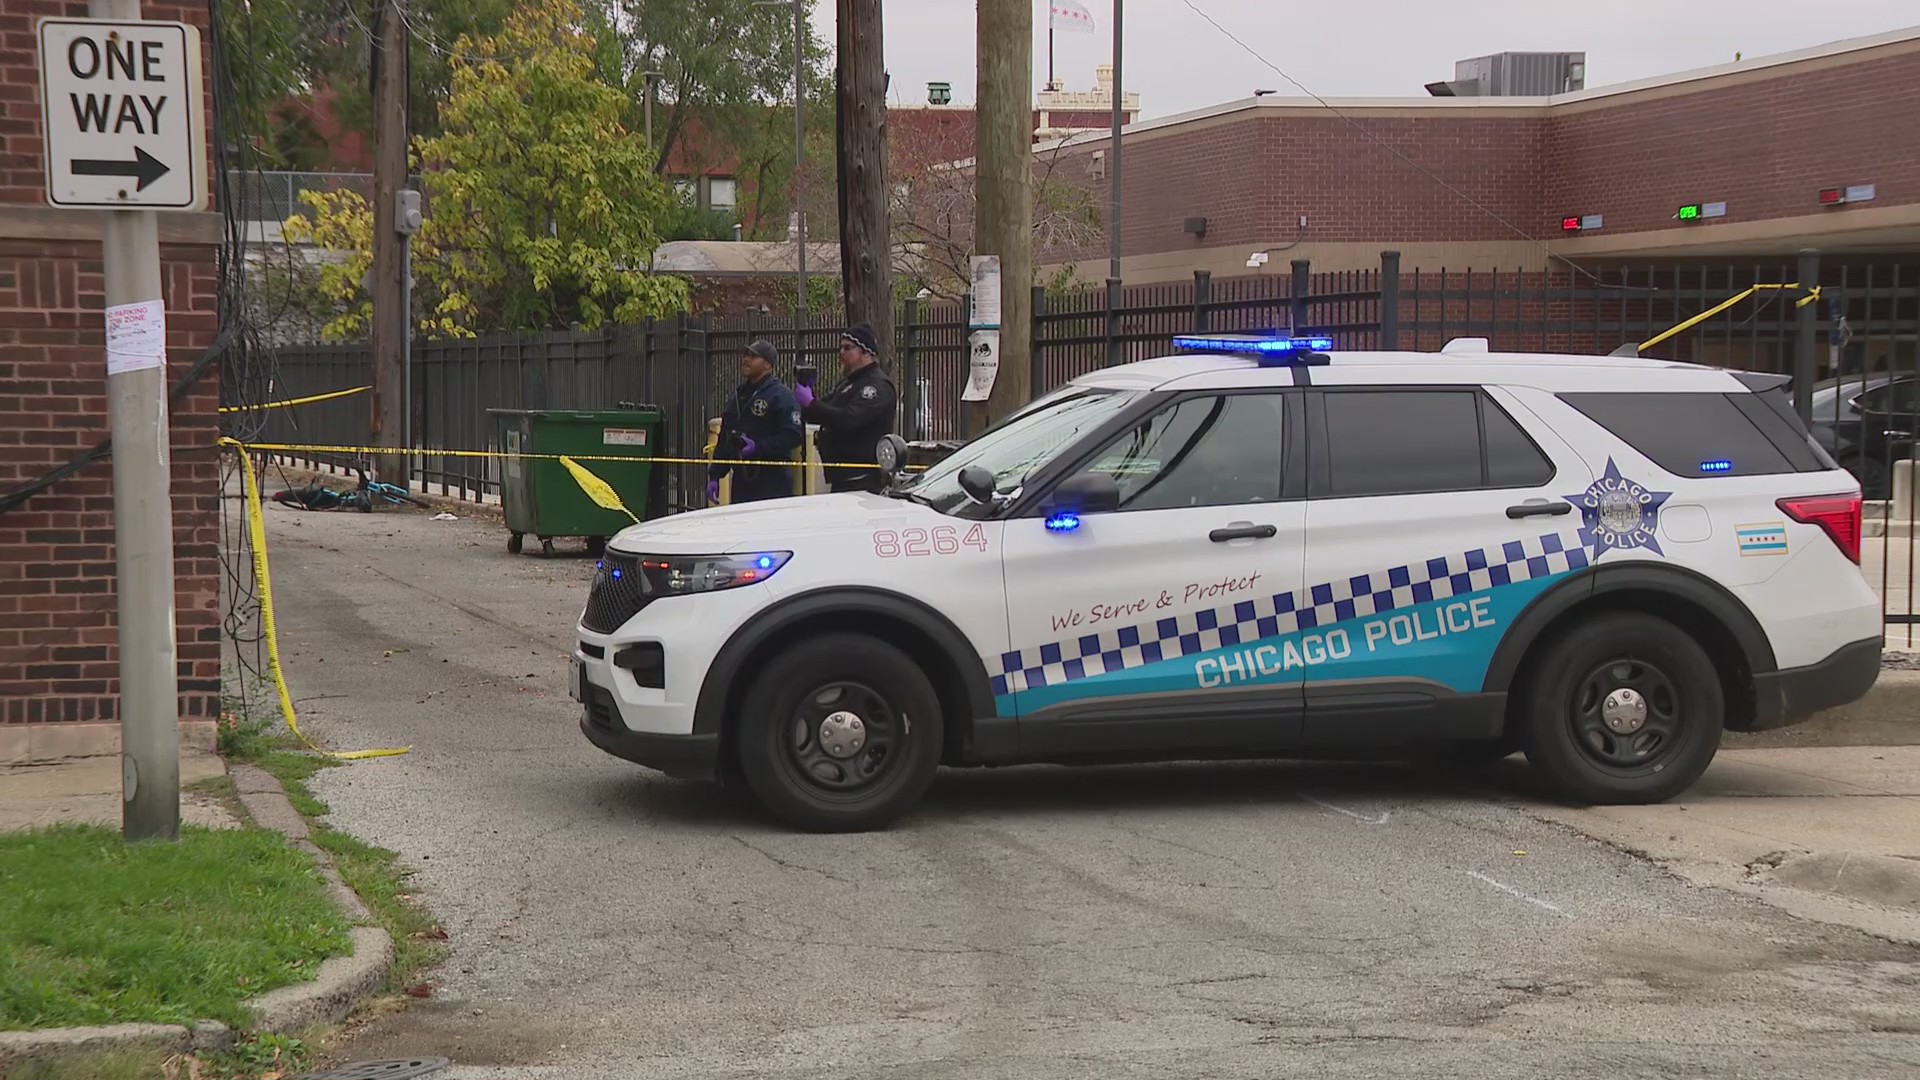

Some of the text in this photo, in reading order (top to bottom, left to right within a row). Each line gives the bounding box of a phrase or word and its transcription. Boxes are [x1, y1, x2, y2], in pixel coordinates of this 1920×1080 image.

[68, 36, 165, 82] ONE
[69, 92, 167, 135] WAY
[115, 307, 148, 316] PARKING
[124, 314, 145, 323] ZONE
[1583, 478, 1652, 508] CHICAGO
[873, 523, 987, 558] 8264
[1591, 523, 1655, 548] POLICE
[1051, 570, 1262, 632] We Serve & Protect
[1194, 596, 1496, 689] CHICAGO POLICE
